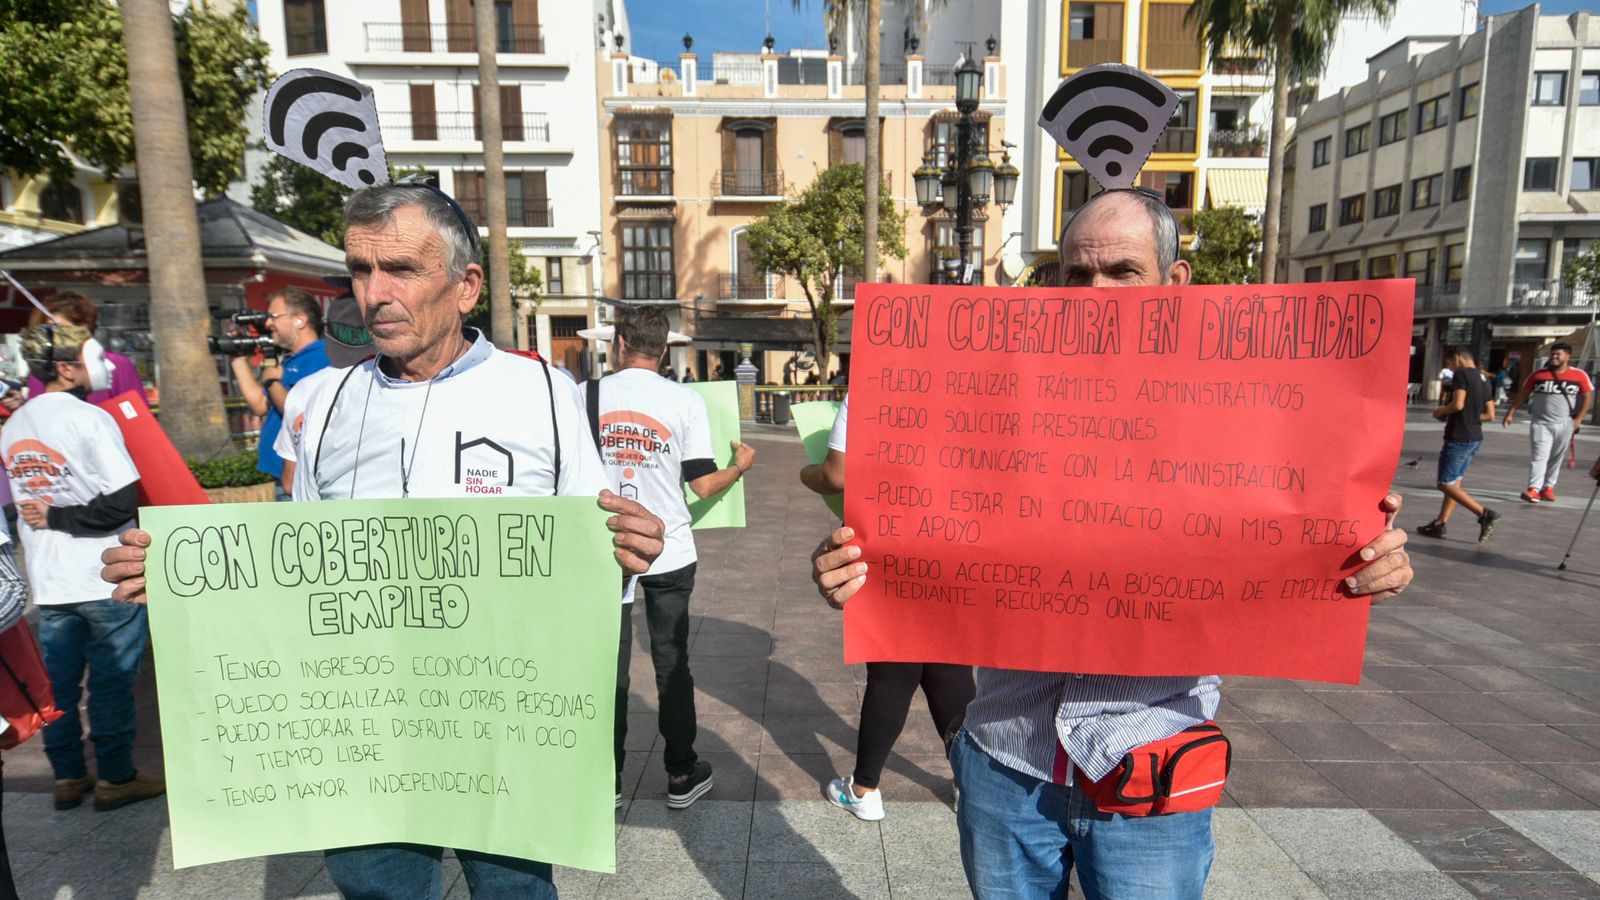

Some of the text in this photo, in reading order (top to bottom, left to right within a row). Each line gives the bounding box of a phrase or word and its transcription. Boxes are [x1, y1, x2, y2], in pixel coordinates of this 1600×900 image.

[867, 294, 931, 349] CON
[947, 297, 1121, 356] COBERTURA
[1138, 296, 1182, 355] EN
[1198, 293, 1384, 361] DIGITALIDAD
[945, 369, 1019, 398] REALIZAR
[1036, 371, 1118, 402] TRÁMITES
[1135, 378, 1305, 411] ADMINISTRATIVOS
[602, 423, 658, 439] FUERA DE
[944, 409, 1021, 437] SOLICITAR
[1031, 412, 1158, 442] PRESTACIONES
[599, 435, 671, 455] OBERTURA
[465, 477, 483, 485] SIN
[466, 468, 498, 478] NADIE
[938, 446, 1049, 474] COMUNICARME
[1063, 453, 1098, 478] CON
[1113, 457, 1134, 482] LA
[1147, 458, 1306, 493] ADMINISTRACIÓN
[465, 485, 503, 494] HOGAR
[878, 514, 981, 544] DE APOYO
[950, 489, 1004, 515] ESTAR
[1019, 495, 1042, 519] EN
[1062, 499, 1163, 530] CONTACTO
[1183, 512, 1222, 538] CON
[1241, 517, 1282, 546] MIS
[1300, 518, 1361, 549] REDES
[164, 513, 555, 597] CON COBERTURA EN
[954, 561, 1042, 589] ACCEDER
[1058, 569, 1074, 589] A
[1088, 571, 1111, 591] LA
[1124, 571, 1225, 601] BÚSQUEDA
[1240, 580, 1270, 601] DE
[309, 584, 469, 636] EMPLEO
[884, 579, 1174, 622] MEDIANTE RECURSOS ONLINE
[213, 654, 281, 681] TENGO
[300, 655, 395, 679] INGRESOS
[412, 654, 538, 682] ECONÓMICOS
[214, 693, 288, 714] PUEDO
[299, 688, 409, 710] SOCIALIZAR
[419, 688, 450, 708] CON
[459, 690, 506, 713] OTRAS
[516, 690, 596, 720] PERSONAS
[216, 721, 270, 744] PUEDO
[277, 718, 354, 740] MEJORAR
[362, 718, 381, 736] EL
[391, 718, 464, 740] DISFRUTE
[473, 720, 493, 740] DE
[506, 724, 526, 743] MI
[535, 726, 577, 749] OCIO
[223, 743, 385, 773] Y TIEMPO LIBRE
[221, 784, 277, 807] TENGO
[286, 777, 349, 800] MAYOR
[368, 771, 510, 796] INDEPENDENCIA
